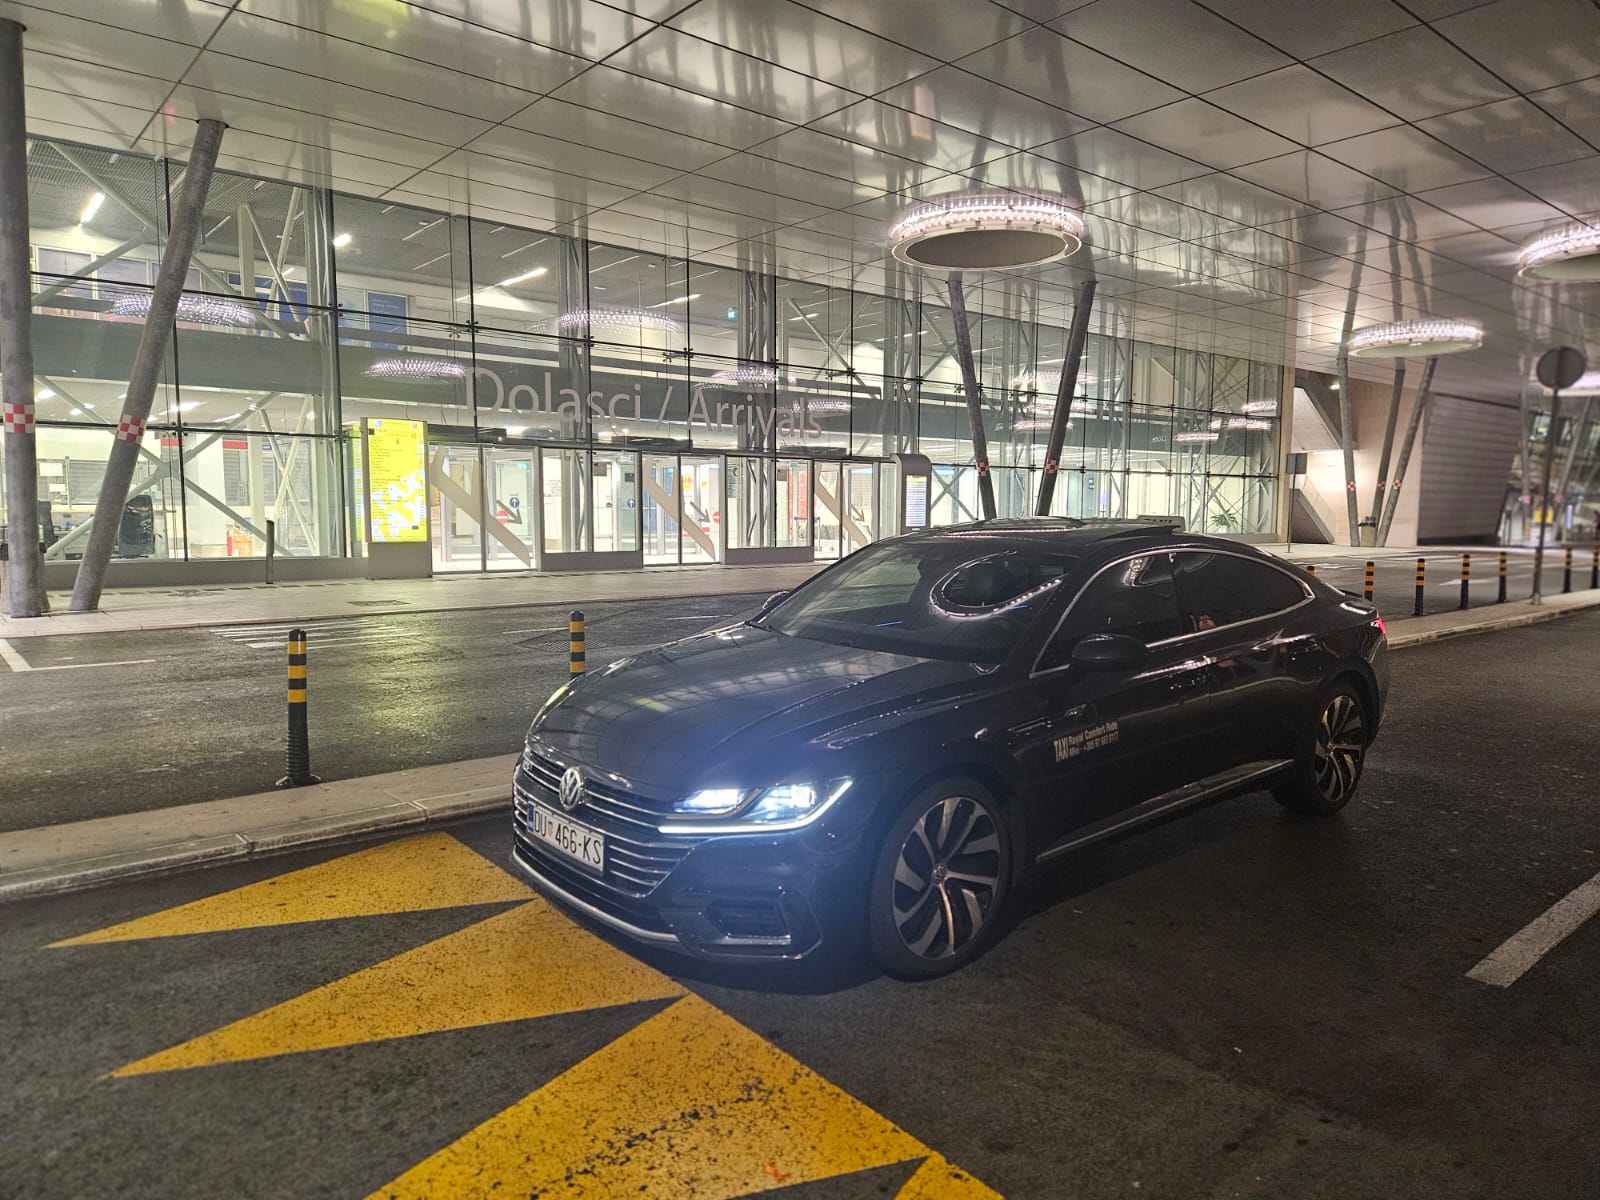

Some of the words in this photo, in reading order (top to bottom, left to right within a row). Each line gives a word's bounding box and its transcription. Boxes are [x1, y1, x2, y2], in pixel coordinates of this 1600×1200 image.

[464, 366, 642, 425] Dolasci
[656, 386, 672, 430] /
[685, 388, 822, 439] Arrivals
[1053, 736, 1069, 762] TAXI
[534, 811, 547, 837] DU
